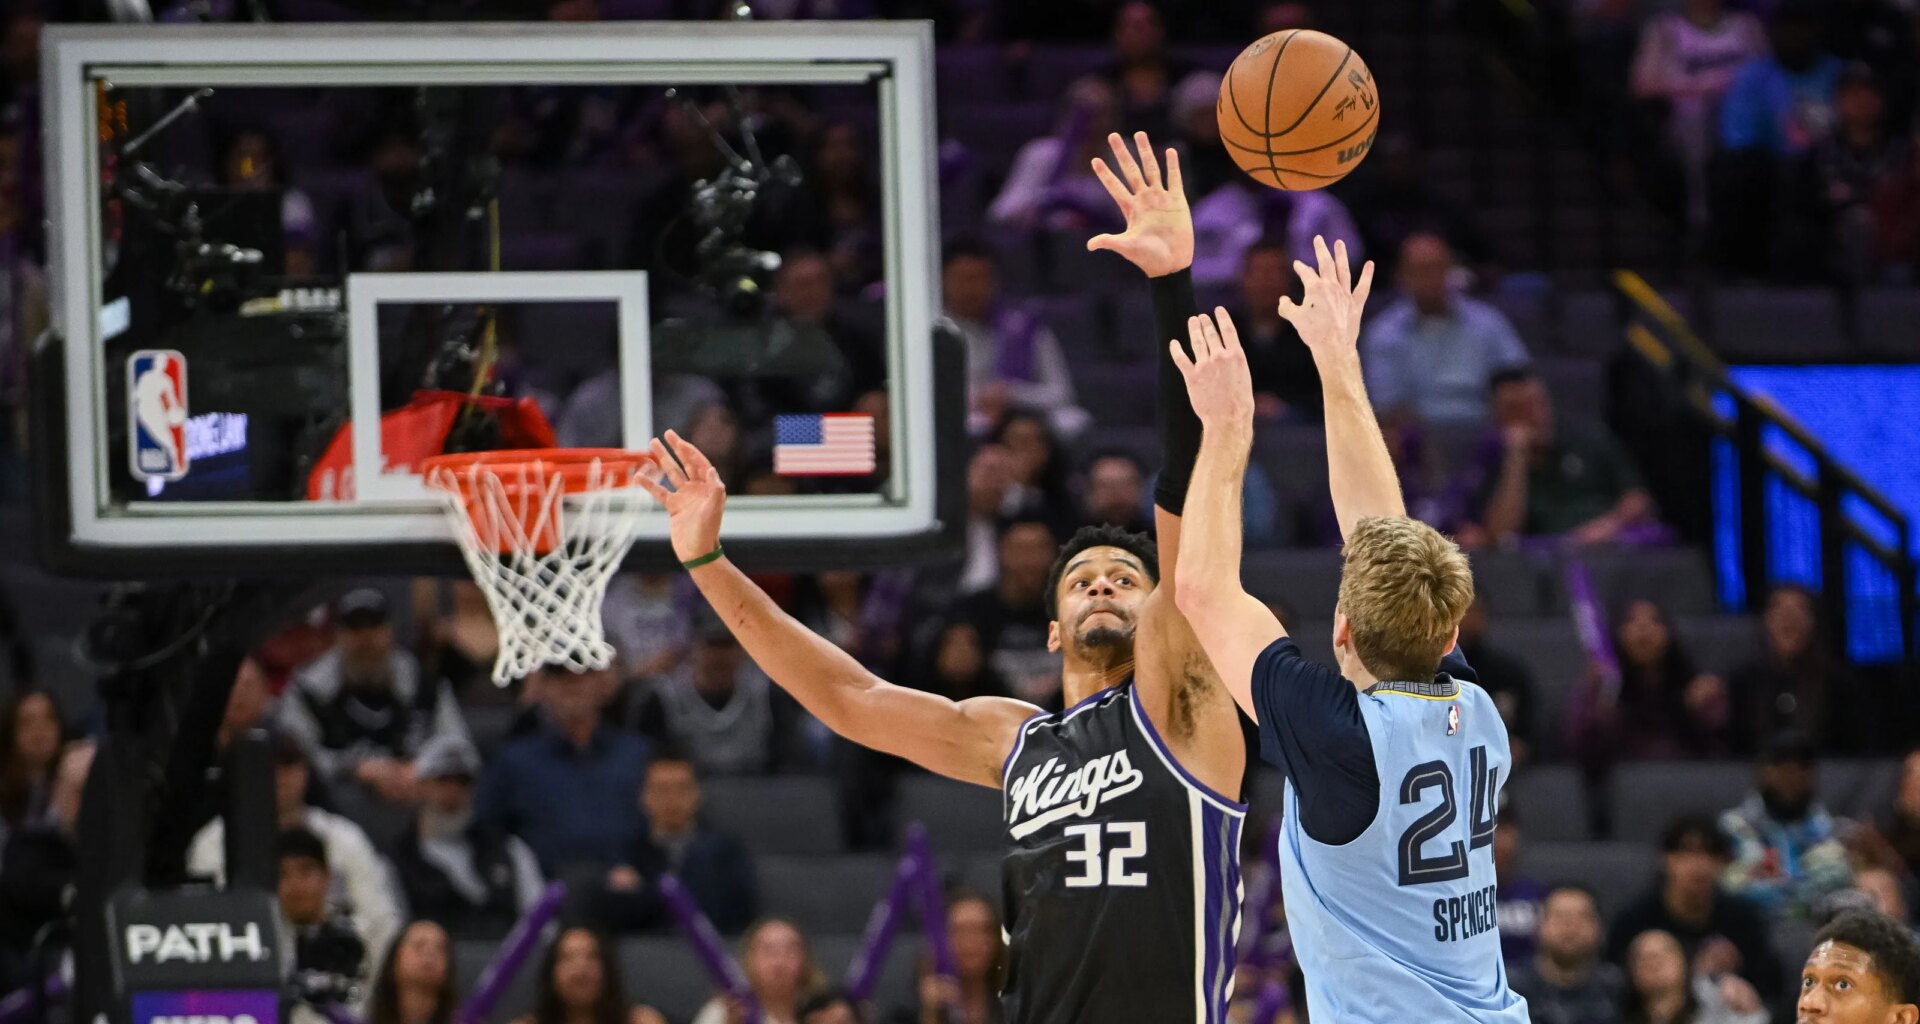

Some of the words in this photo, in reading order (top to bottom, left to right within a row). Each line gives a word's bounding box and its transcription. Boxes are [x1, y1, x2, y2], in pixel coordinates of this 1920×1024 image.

[1009, 748, 1144, 841] Kings
[1397, 744, 1499, 887] 24
[1063, 821, 1148, 888] 32
[1432, 884, 1498, 943] SPENCER
